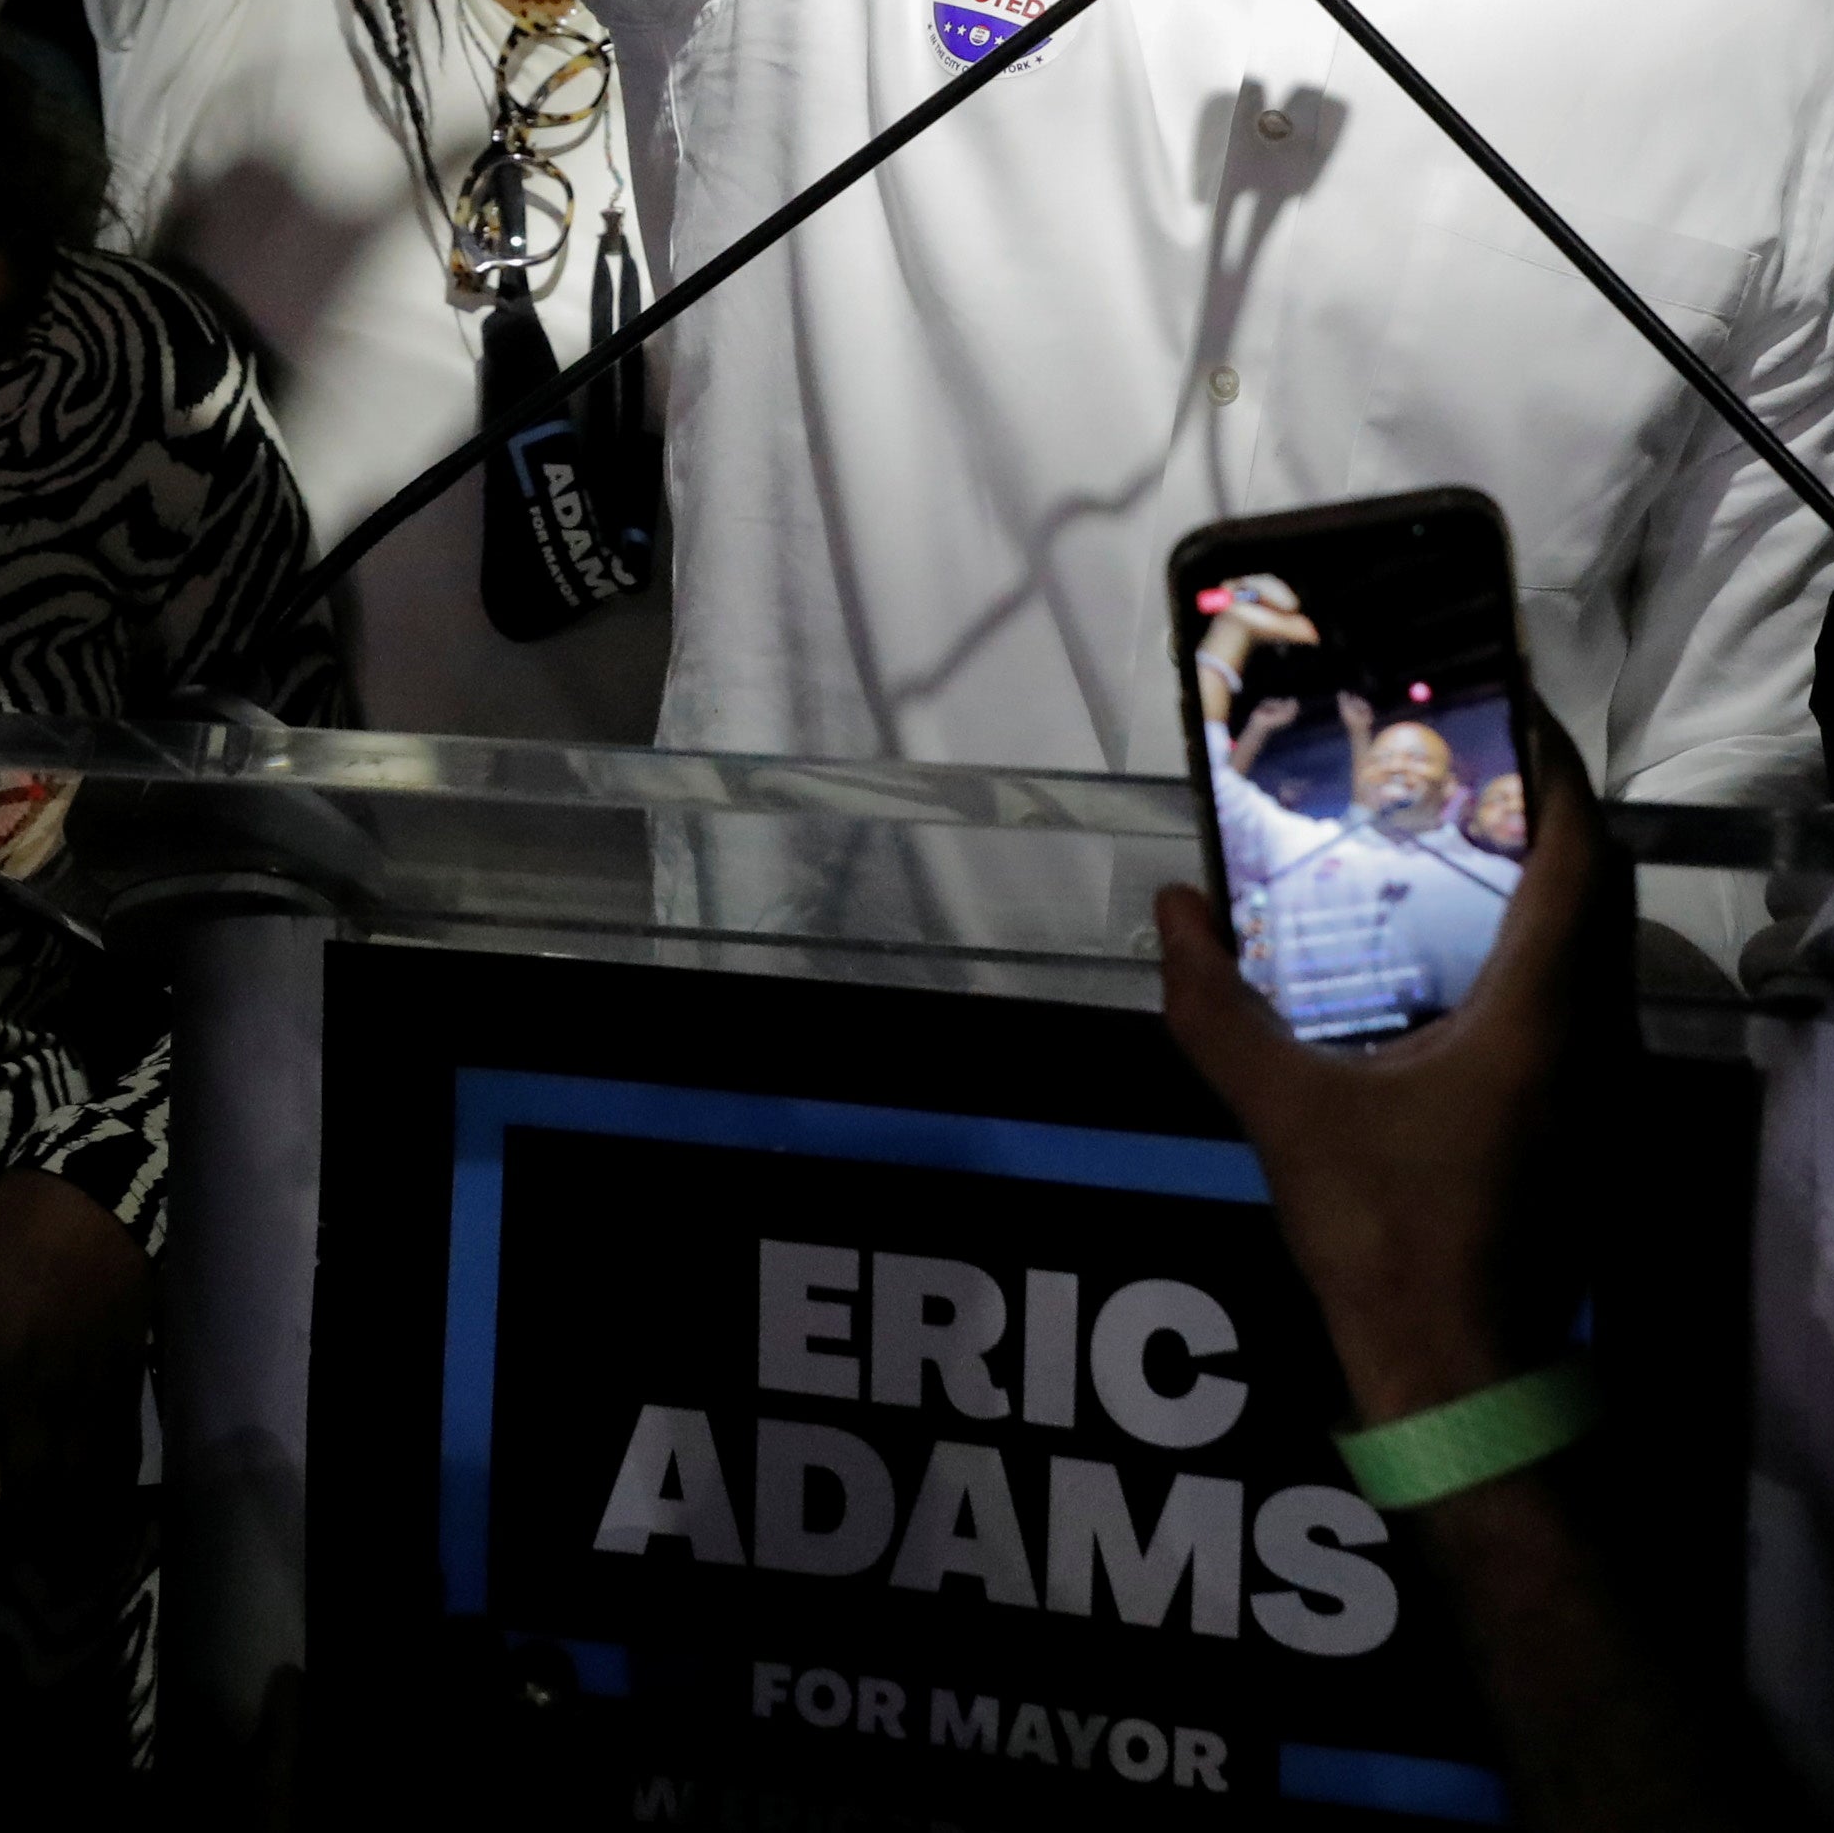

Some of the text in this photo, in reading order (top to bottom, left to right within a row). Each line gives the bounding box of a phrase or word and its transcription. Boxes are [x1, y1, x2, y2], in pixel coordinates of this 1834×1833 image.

[928, 33, 937, 45] IN
[933, 43, 944, 59] THE
[943, 56, 961, 71] CITY
[541, 462, 619, 600] ADAM
[759, 1239, 1249, 1449] ERIC
[592, 1403, 1399, 1657] ADAMS
[751, 1661, 1229, 1793] FOR MAYOR
